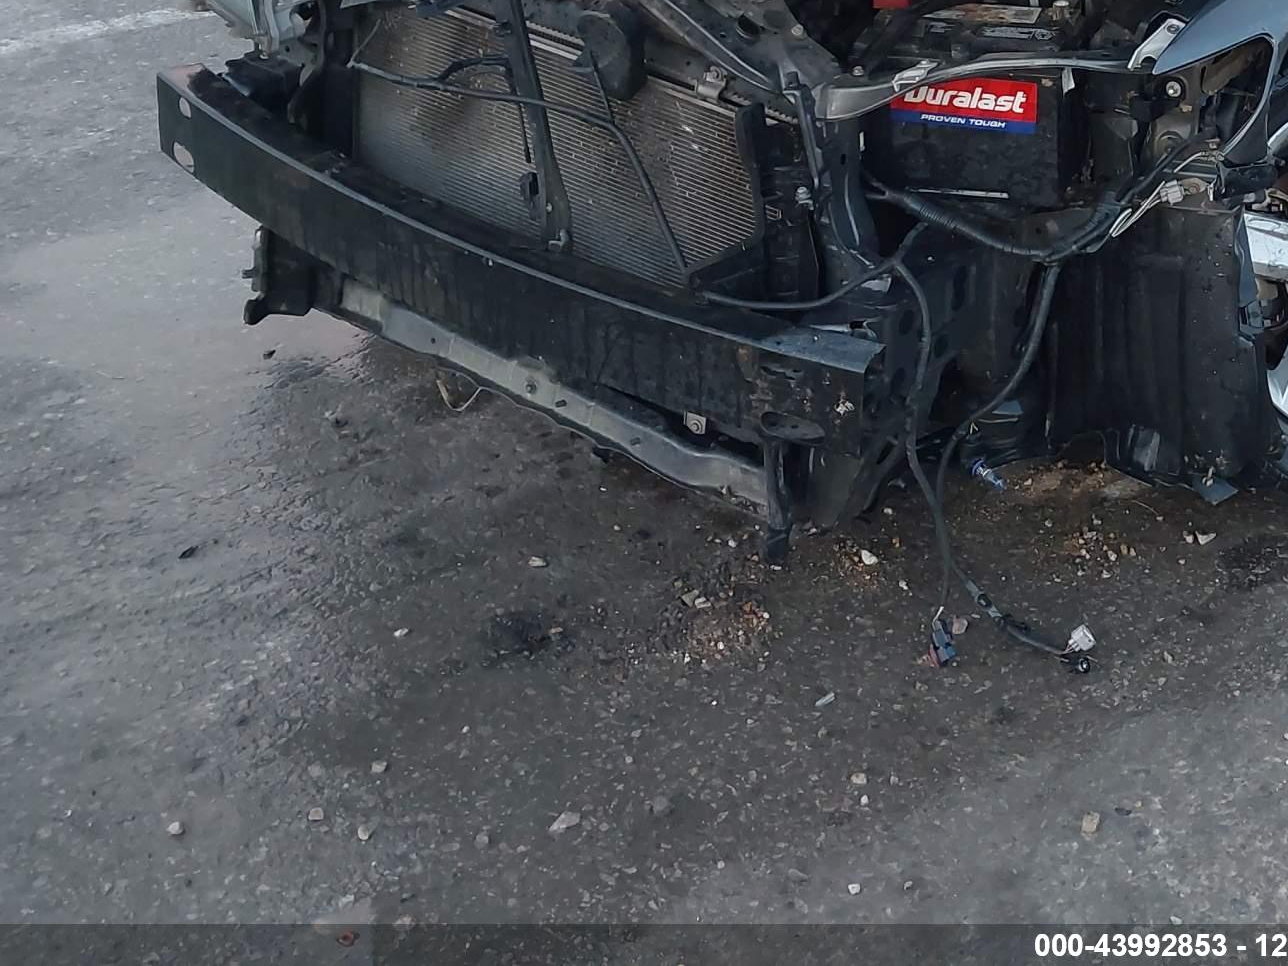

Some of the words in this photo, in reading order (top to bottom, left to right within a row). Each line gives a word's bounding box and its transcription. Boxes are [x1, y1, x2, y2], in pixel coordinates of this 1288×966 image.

[904, 85, 1027, 113] Duralast
[920, 113, 966, 125] PROVEN
[969, 118, 1006, 129] TOUGH
